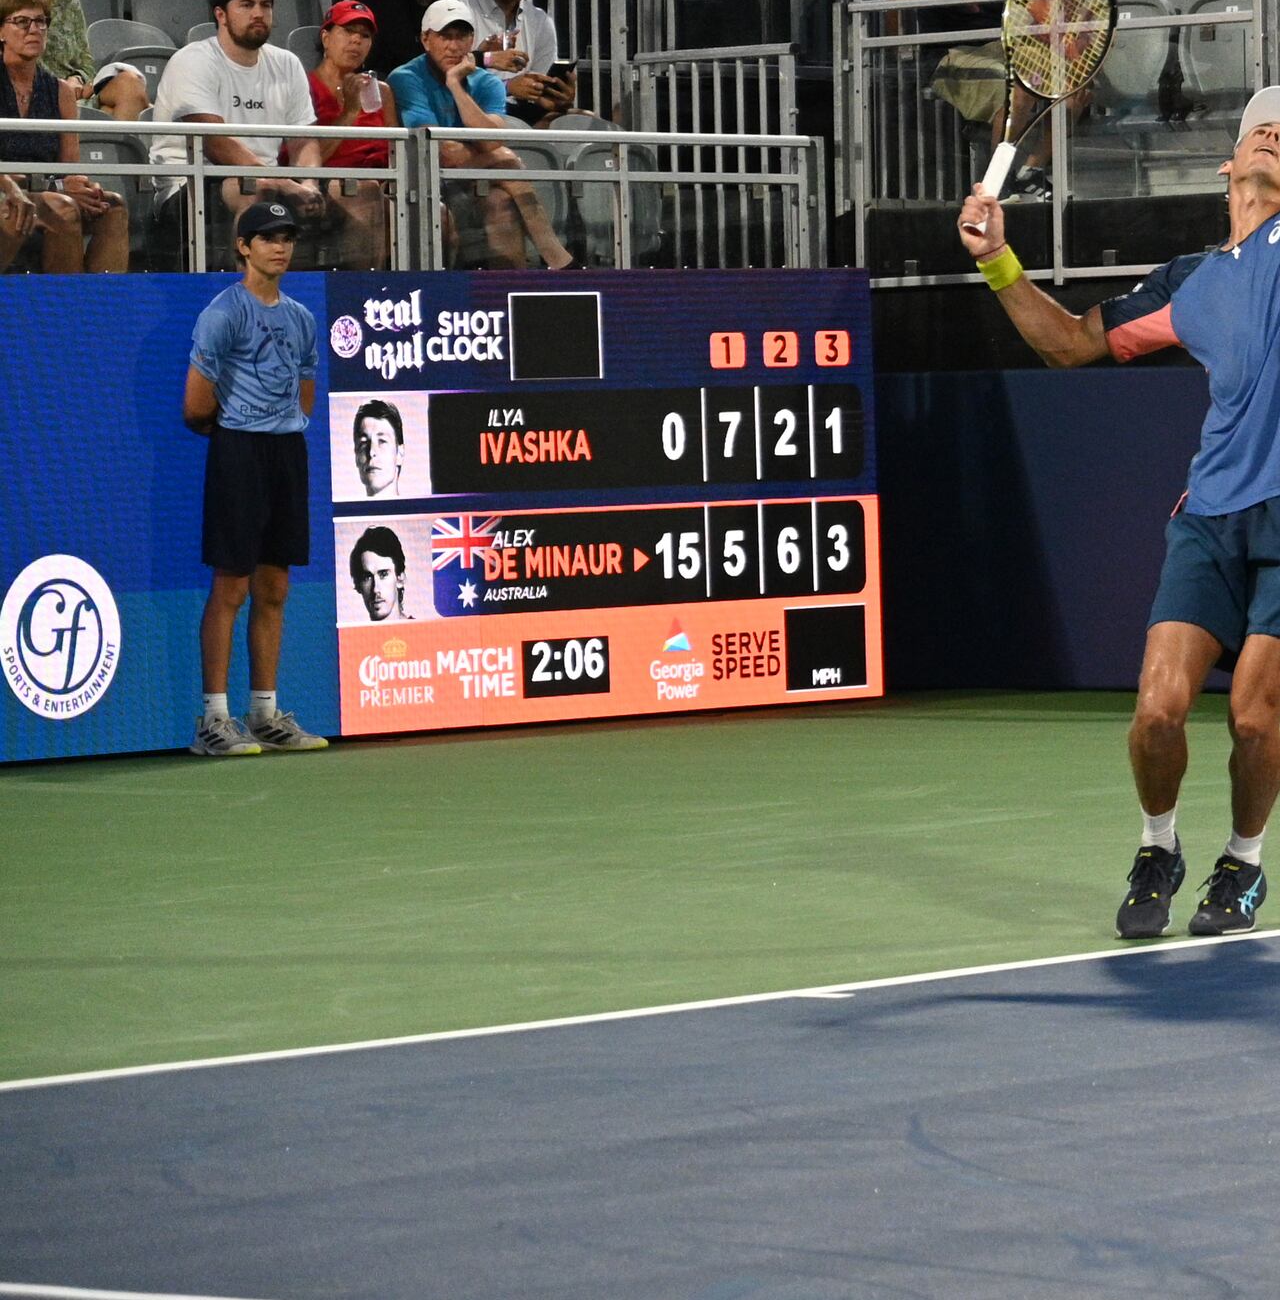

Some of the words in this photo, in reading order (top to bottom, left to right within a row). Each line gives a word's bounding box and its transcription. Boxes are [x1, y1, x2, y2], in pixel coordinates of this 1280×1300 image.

[437, 310, 505, 336] SHOT
[426, 336, 504, 361] CLOCK
[722, 336, 735, 363] 1
[772, 335, 789, 362] 2
[824, 334, 841, 361] 3
[487, 408, 524, 426] ILYA
[479, 429, 592, 465] IVASHKA
[661, 411, 687, 461] 0
[718, 411, 742, 458] 7
[773, 408, 798, 456] 2
[825, 407, 843, 454] 1
[490, 529, 536, 548] ALEX
[655, 531, 702, 579] 15
[722, 529, 746, 577] 5
[776, 526, 800, 574] 6
[826, 524, 850, 572] 3
[484, 548, 517, 581] DE
[525, 542, 624, 579] MINAUR
[483, 585, 548, 602] AUSTRALIA
[711, 630, 781, 656] SERVE
[359, 655, 432, 686] Corona
[436, 648, 514, 675] MATCH
[531, 638, 606, 682] 2:06
[650, 658, 705, 682] Georgia
[712, 654, 782, 681] SPEED
[4, 646, 32, 698] SPORTS
[32, 693, 40, 706] &
[43, 641, 116, 713] ENTERTAINMENT
[459, 672, 517, 699] TIME
[812, 667, 842, 685] MPH
[359, 685, 435, 708] PREMIER
[656, 682, 700, 701] Power
